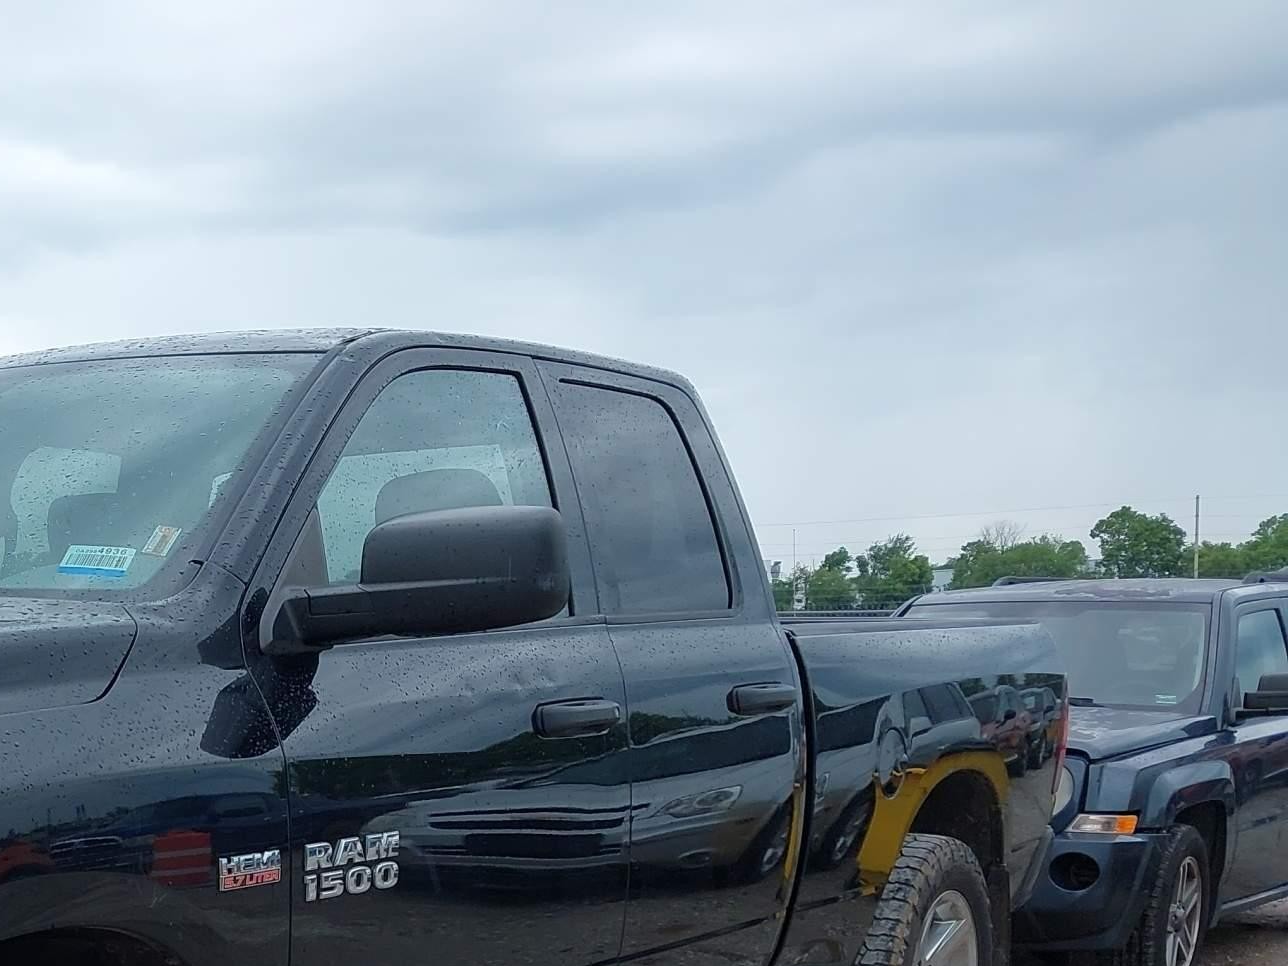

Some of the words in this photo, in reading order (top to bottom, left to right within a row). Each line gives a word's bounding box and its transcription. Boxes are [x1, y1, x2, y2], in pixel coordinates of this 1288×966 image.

[219, 849, 281, 875] HEMI
[303, 831, 401, 872] RAM
[224, 876, 245, 888] 5.7
[246, 870, 279, 885] LITER
[304, 861, 400, 902] 1500
